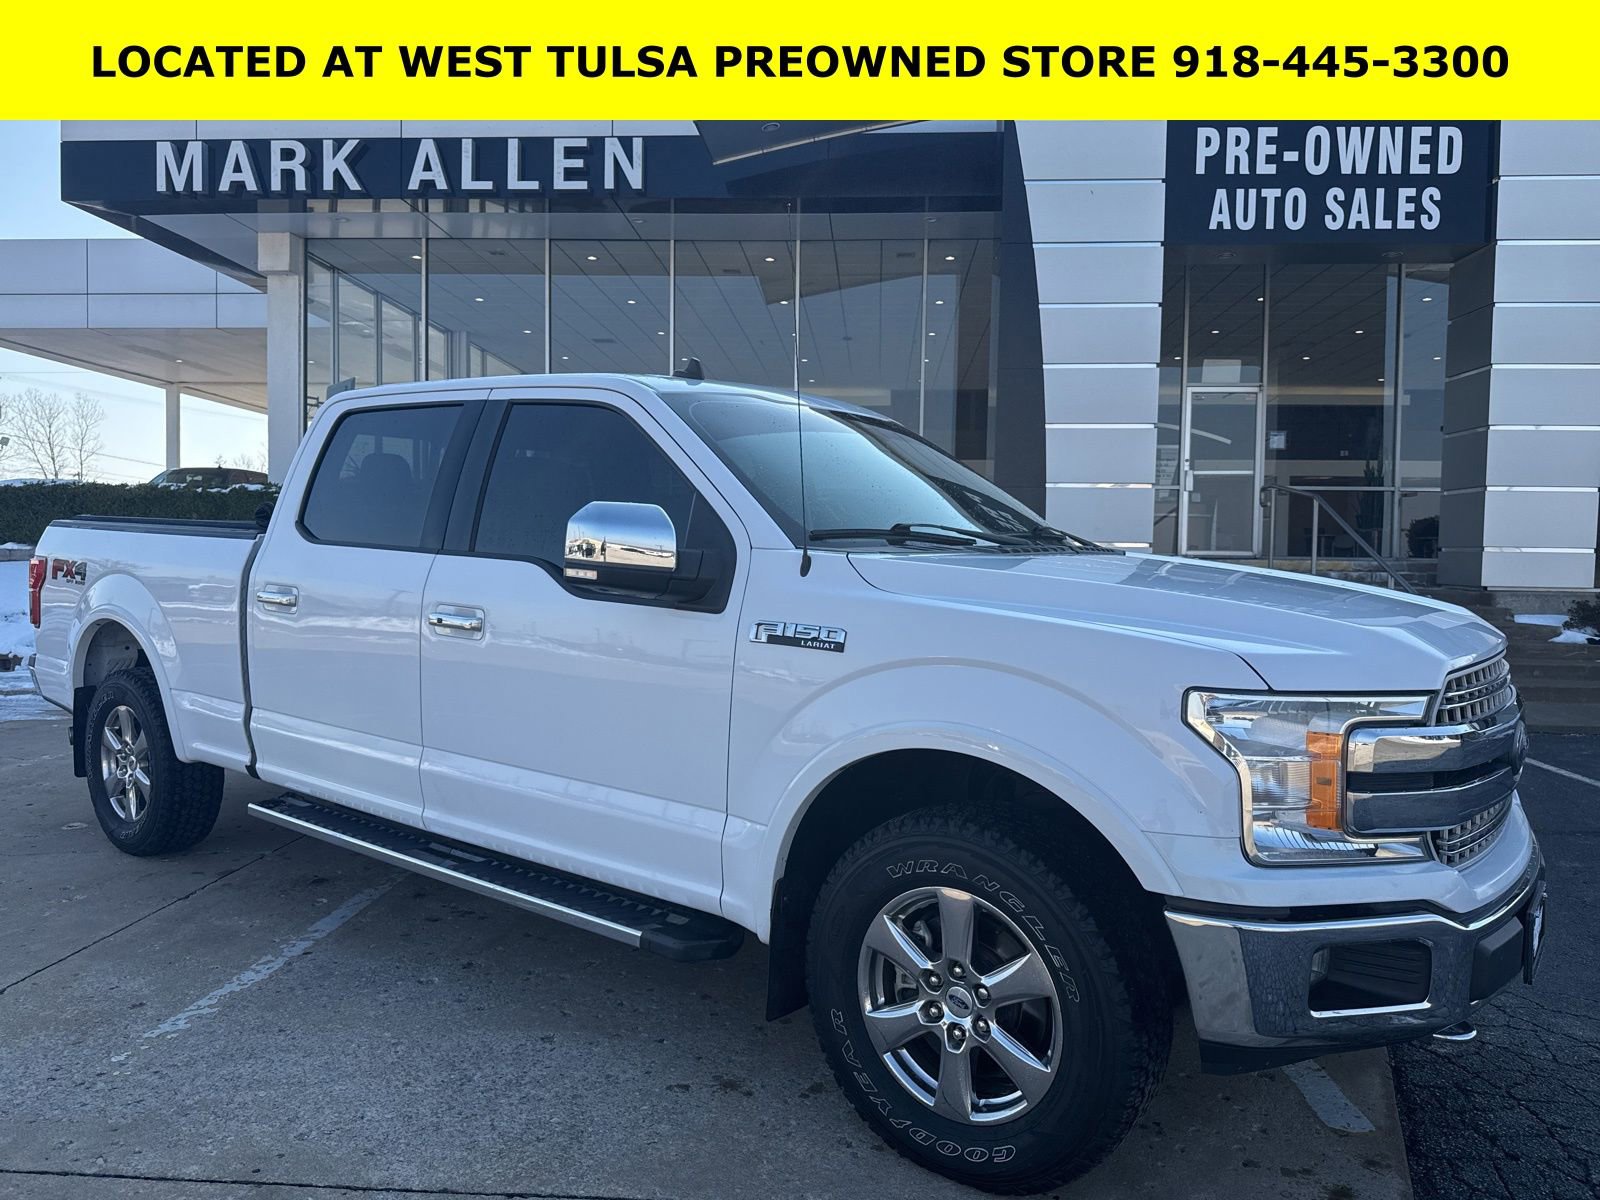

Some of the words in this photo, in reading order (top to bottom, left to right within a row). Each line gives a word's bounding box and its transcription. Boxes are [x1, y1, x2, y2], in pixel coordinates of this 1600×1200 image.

[154, 138, 362, 193] MARK
[407, 137, 645, 192] ALLEN
[1195, 125, 1464, 175] PRE-OWNED
[1208, 187, 1307, 231] AUTO
[1324, 186, 1442, 231] SALES
[52, 559, 87, 581] FX4
[801, 640, 835, 649] LARIAT
[886, 859, 1081, 1004] WRANGLER
[831, 1007, 1017, 1163] GOODYEAR
